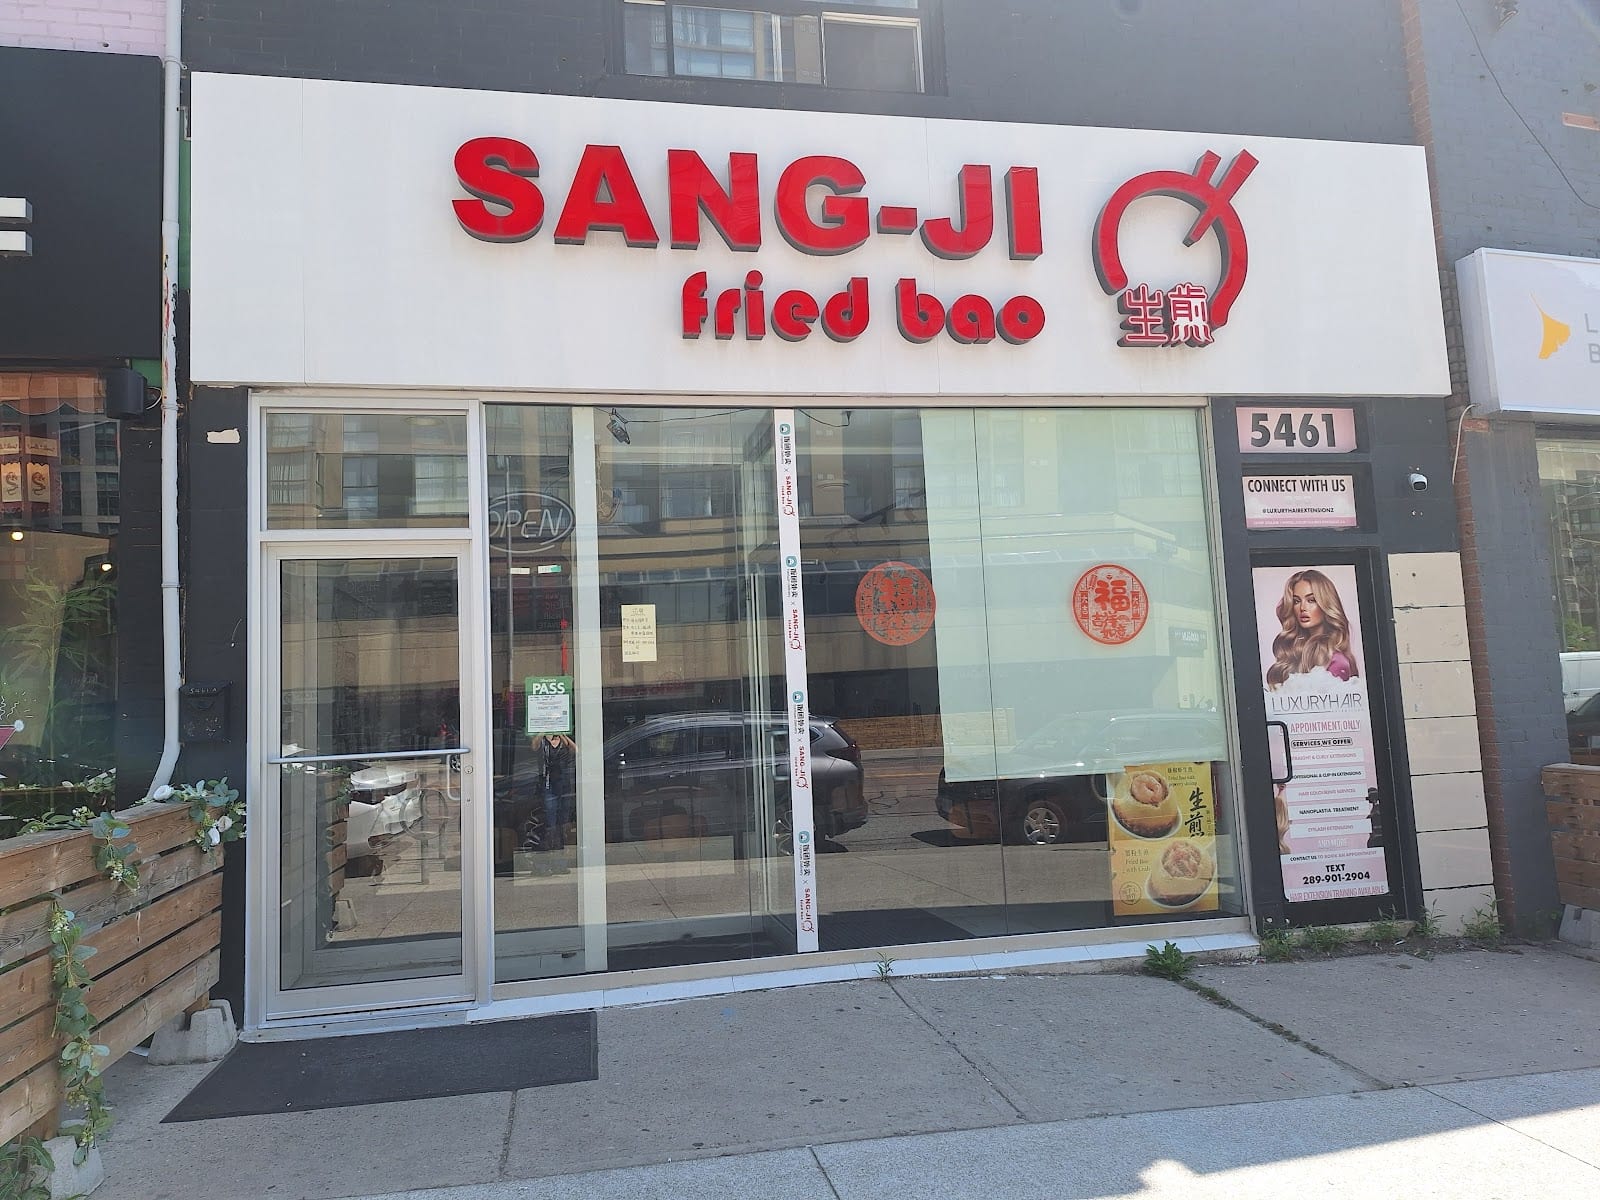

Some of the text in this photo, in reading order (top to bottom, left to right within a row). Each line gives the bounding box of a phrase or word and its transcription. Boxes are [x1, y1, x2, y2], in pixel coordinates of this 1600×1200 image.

[452, 136, 1043, 260] SANG-JI
[682, 270, 1046, 345] fried bao
[1119, 283, 1214, 347] 生煎
[1250, 412, 1337, 448] 5461
[1247, 479, 1346, 493] CONNECT WITH US
[1094, 579, 1131, 611] 福
[532, 682, 566, 695] PASS
[1271, 693, 1362, 712] LUXURYHAIR
[1291, 721, 1341, 733] APPOINTMENT
[1342, 720, 1361, 731] ONLY
[1185, 787, 1206, 838] 生煎
[1302, 871, 1371, 885] 289-901-2904
[1325, 863, 1346, 873] TEXT
